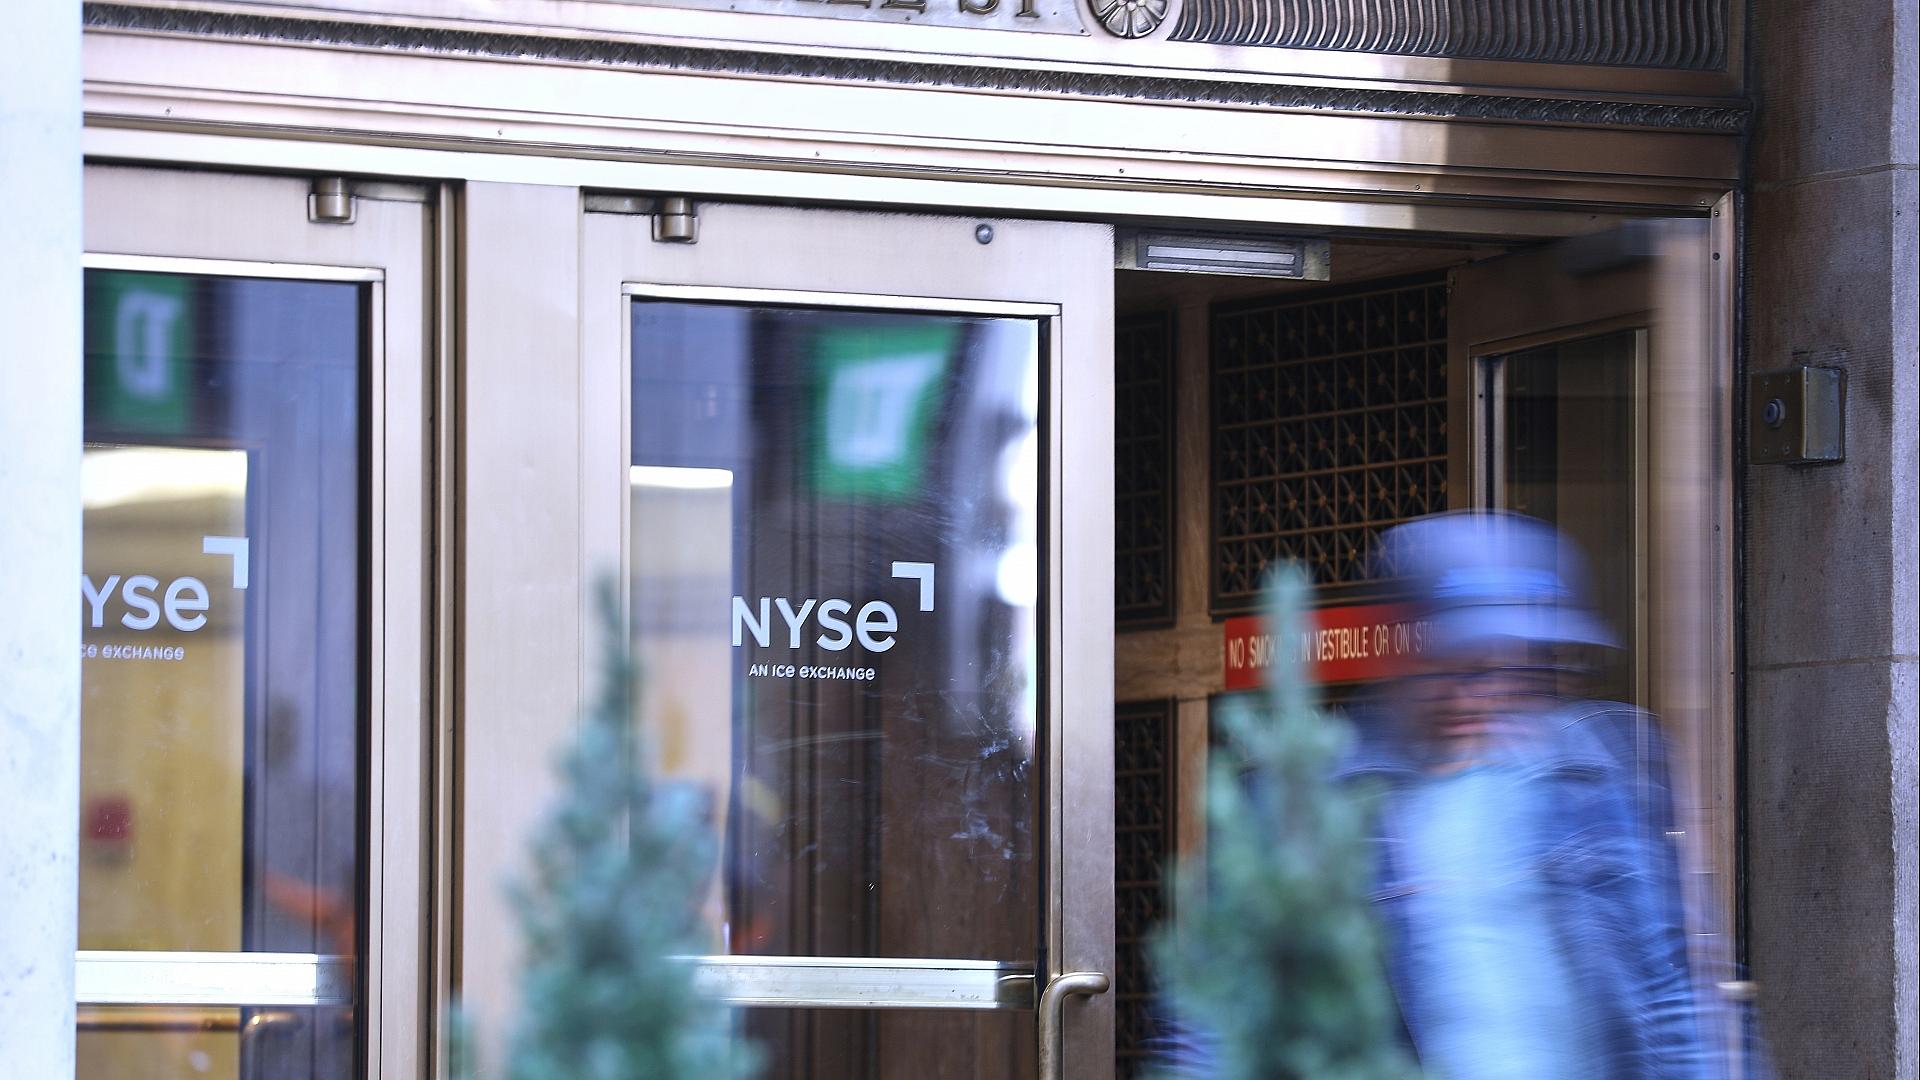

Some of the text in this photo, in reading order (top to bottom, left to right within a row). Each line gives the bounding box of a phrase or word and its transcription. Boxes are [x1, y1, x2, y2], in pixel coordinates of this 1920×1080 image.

[81, 574, 210, 632] YSe
[1229, 637, 1245, 669] NO
[1315, 626, 1369, 661] VESTIBULE
[1374, 624, 1390, 656] OR
[1395, 622, 1410, 655] ON
[749, 663, 769, 677] AN
